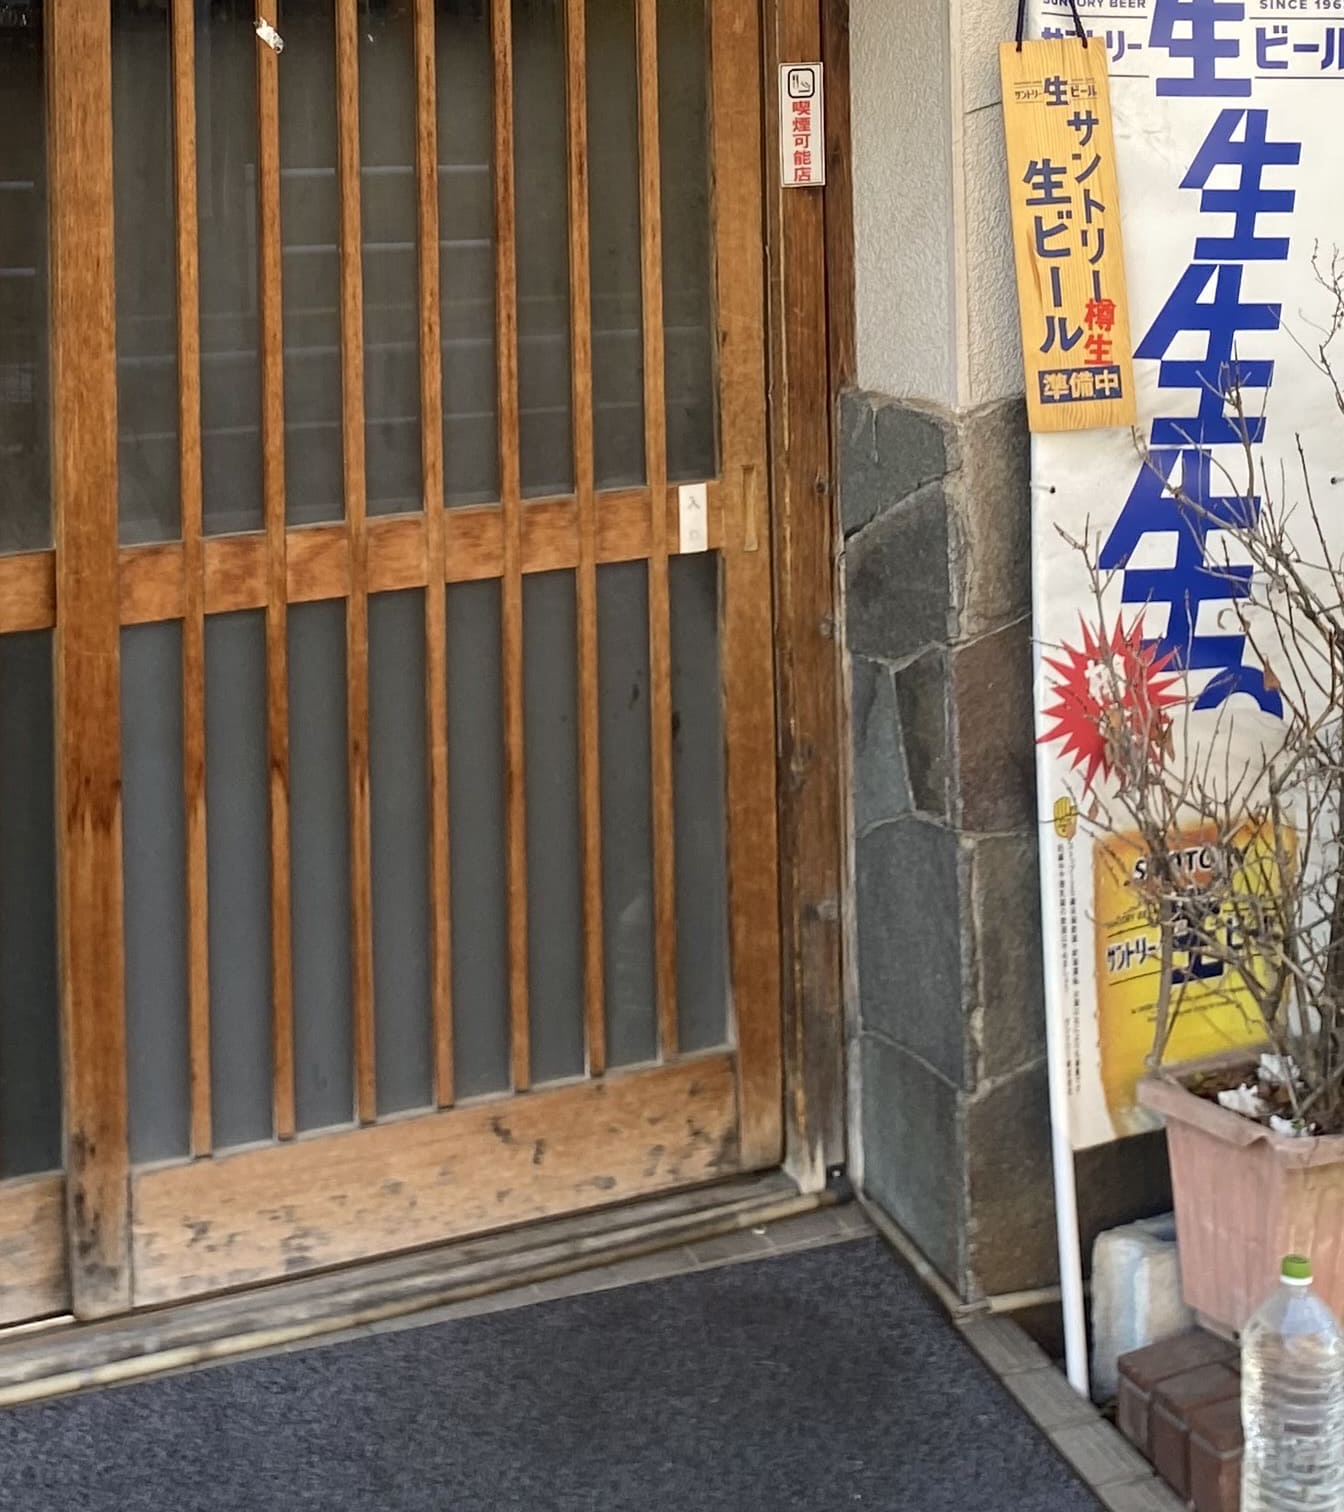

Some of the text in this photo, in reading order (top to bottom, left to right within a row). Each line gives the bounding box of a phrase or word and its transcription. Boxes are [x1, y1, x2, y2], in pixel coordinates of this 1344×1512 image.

[791, 100, 812, 182] 喫煙可能店
[1066, 109, 1106, 303] サントリー
[1022, 157, 1084, 354] 生ビール
[1083, 297, 1117, 366] 樽生
[1043, 369, 1121, 401] 準備中
